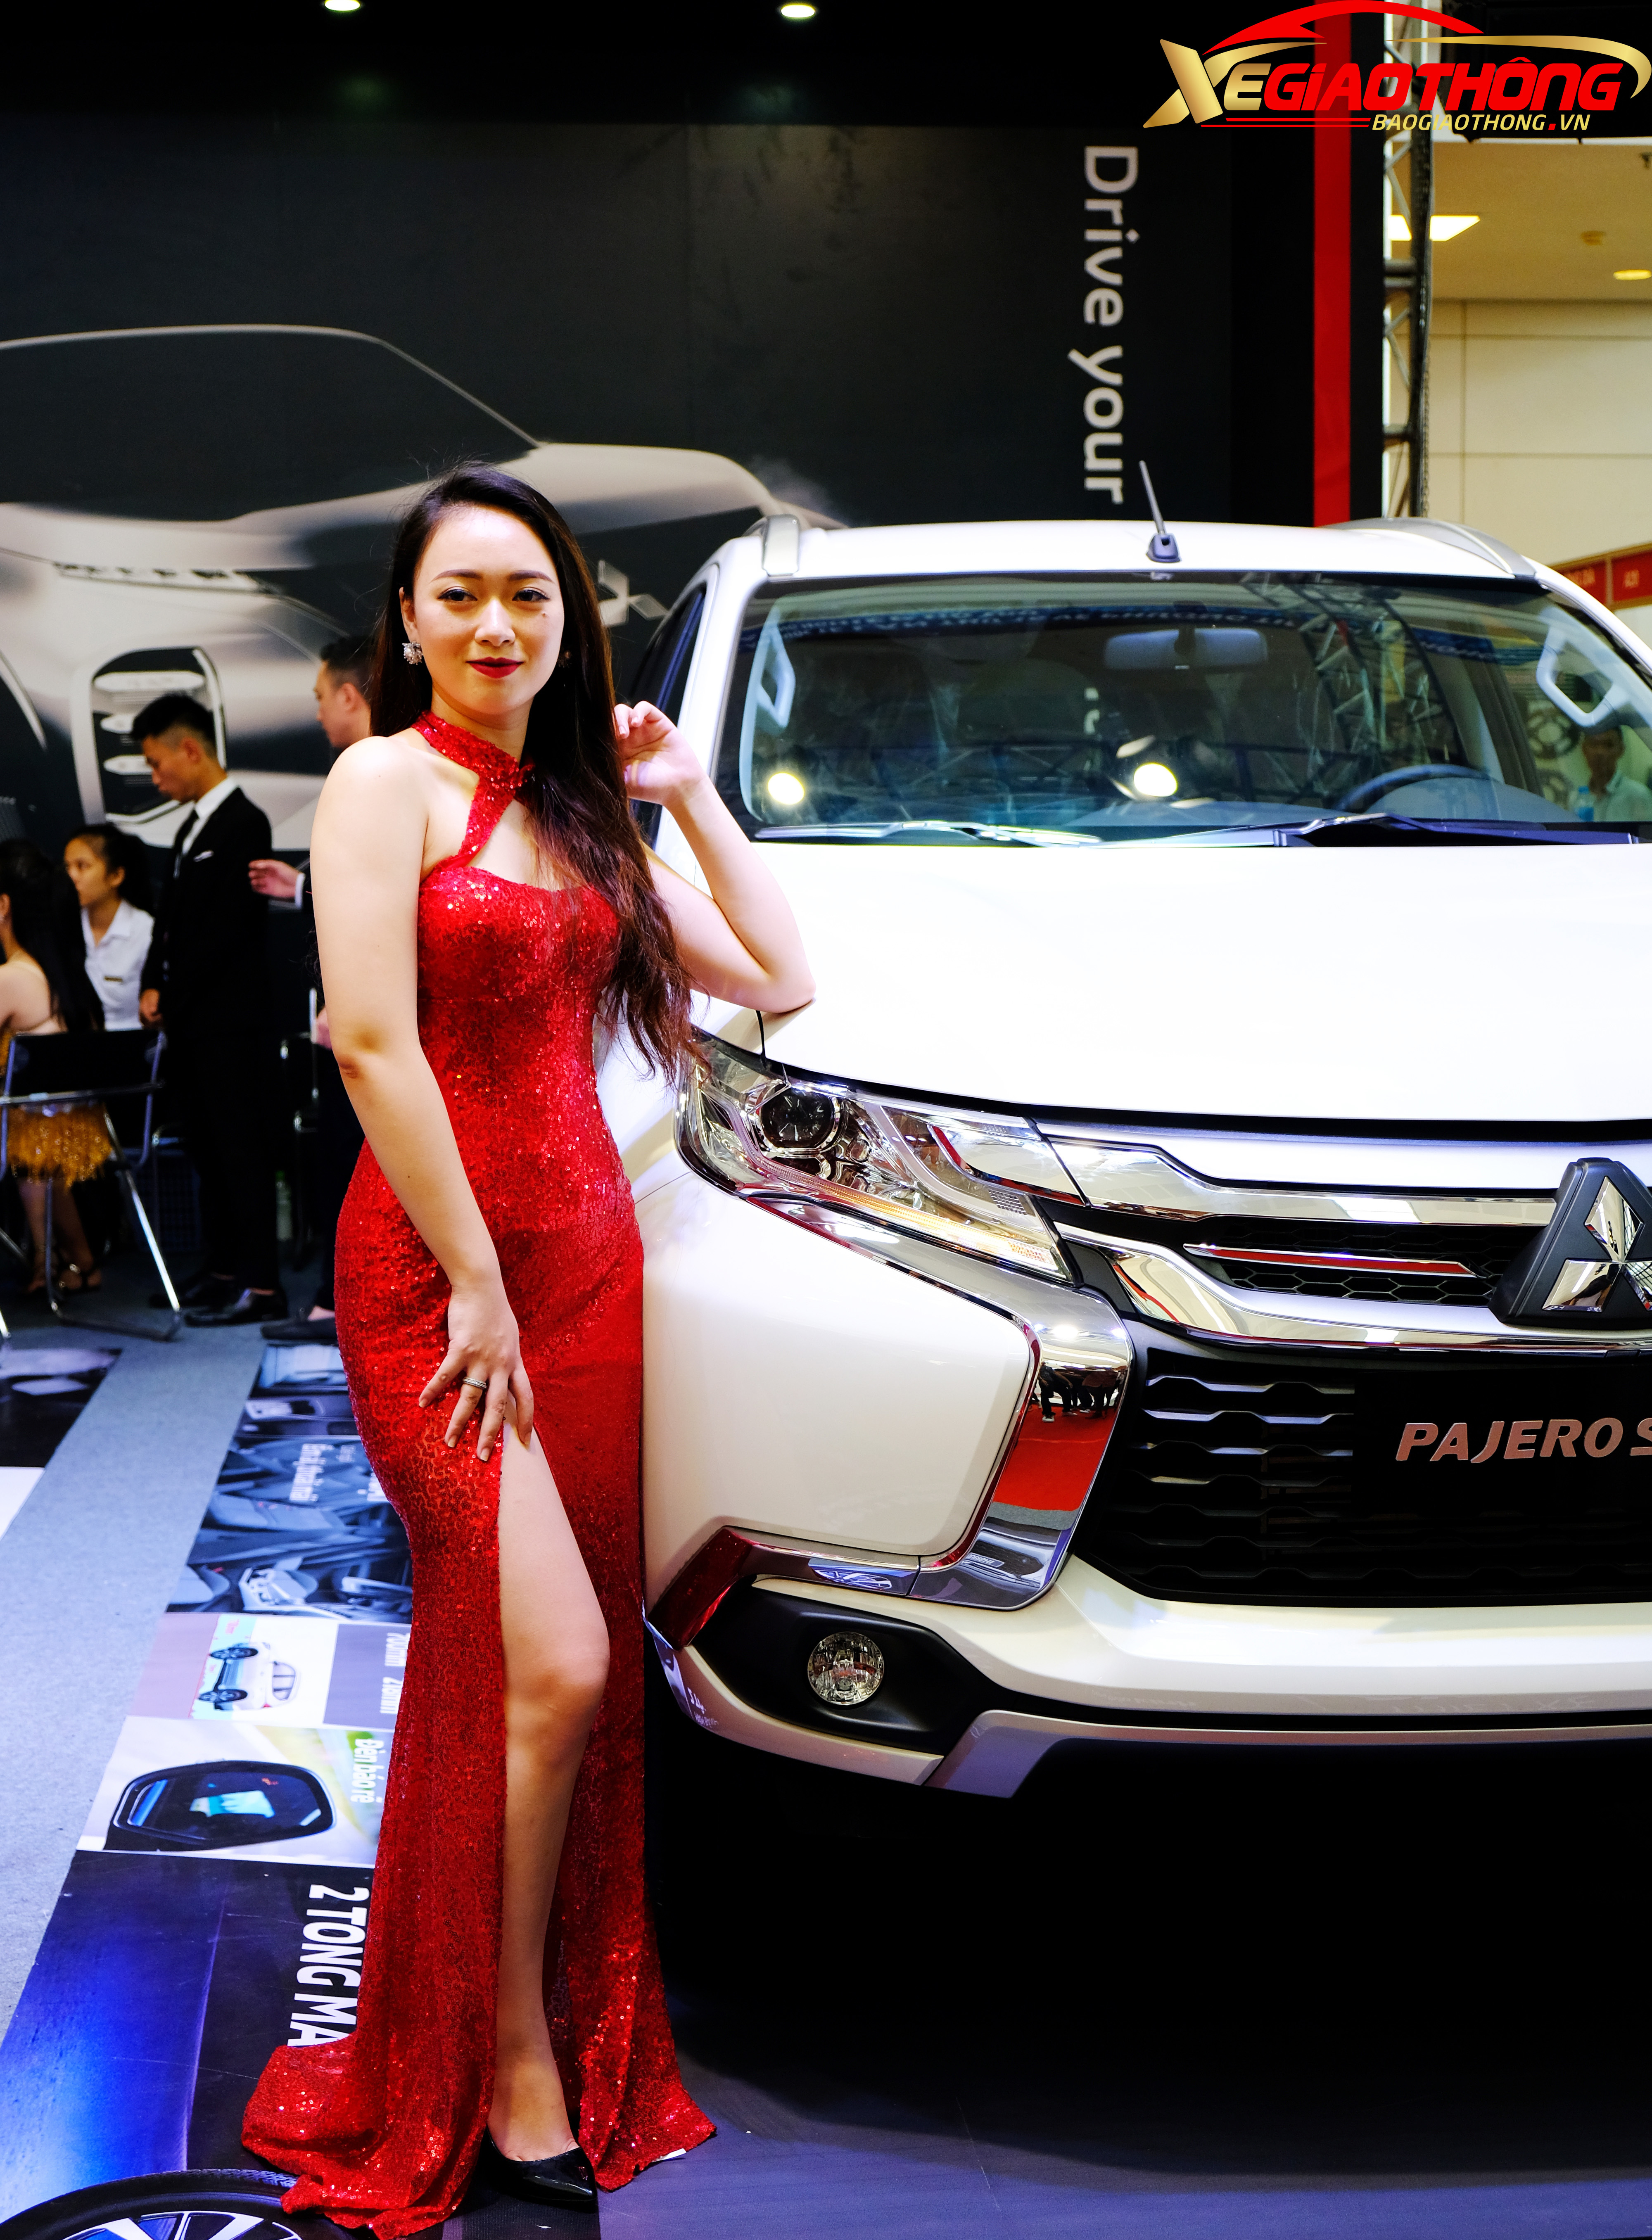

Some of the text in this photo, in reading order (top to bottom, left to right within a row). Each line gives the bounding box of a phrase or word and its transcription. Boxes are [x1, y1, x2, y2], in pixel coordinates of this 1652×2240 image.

[1068, 146, 1139, 504] Drive your
[1396, 1417, 1623, 1464] PAJERO
[309, 1884, 370, 1901] 2
